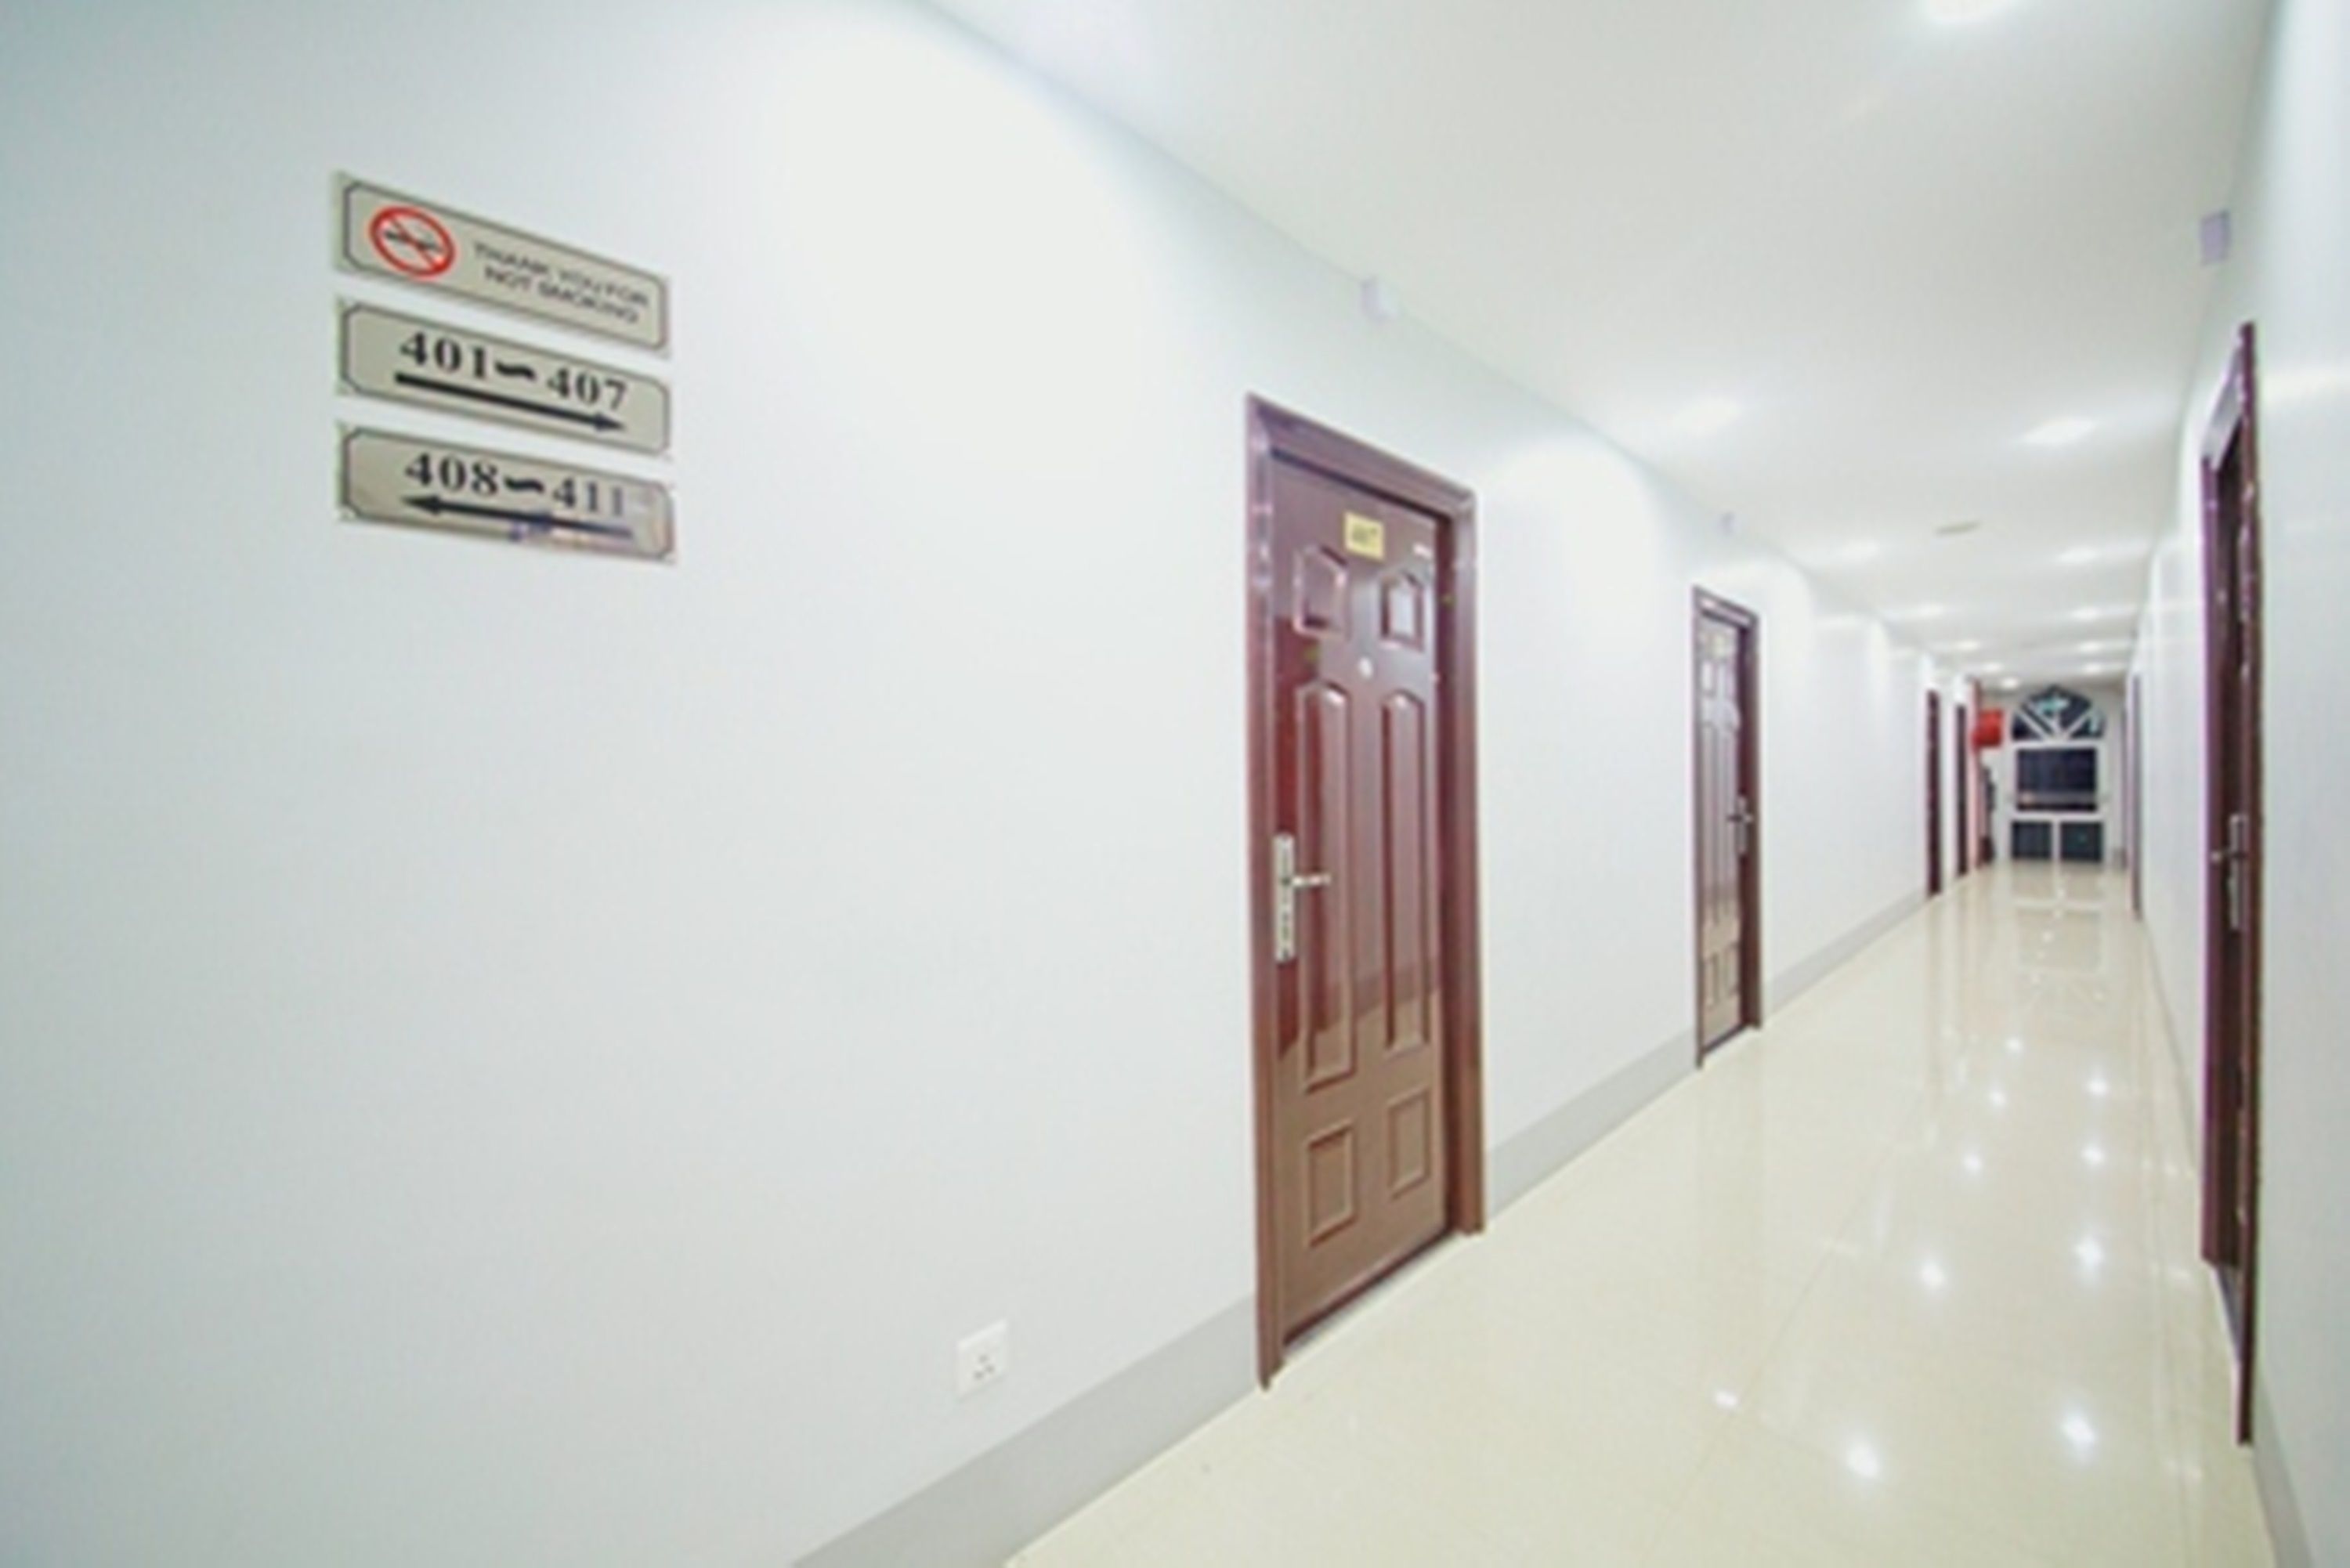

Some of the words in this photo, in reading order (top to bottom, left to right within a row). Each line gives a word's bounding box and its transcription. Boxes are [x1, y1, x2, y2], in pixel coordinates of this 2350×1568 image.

[473, 240, 549, 276] THANK
[559, 269, 602, 294] YOU
[605, 282, 649, 308] FOR
[483, 265, 533, 293] NOT
[538, 280, 640, 323] SMOKING
